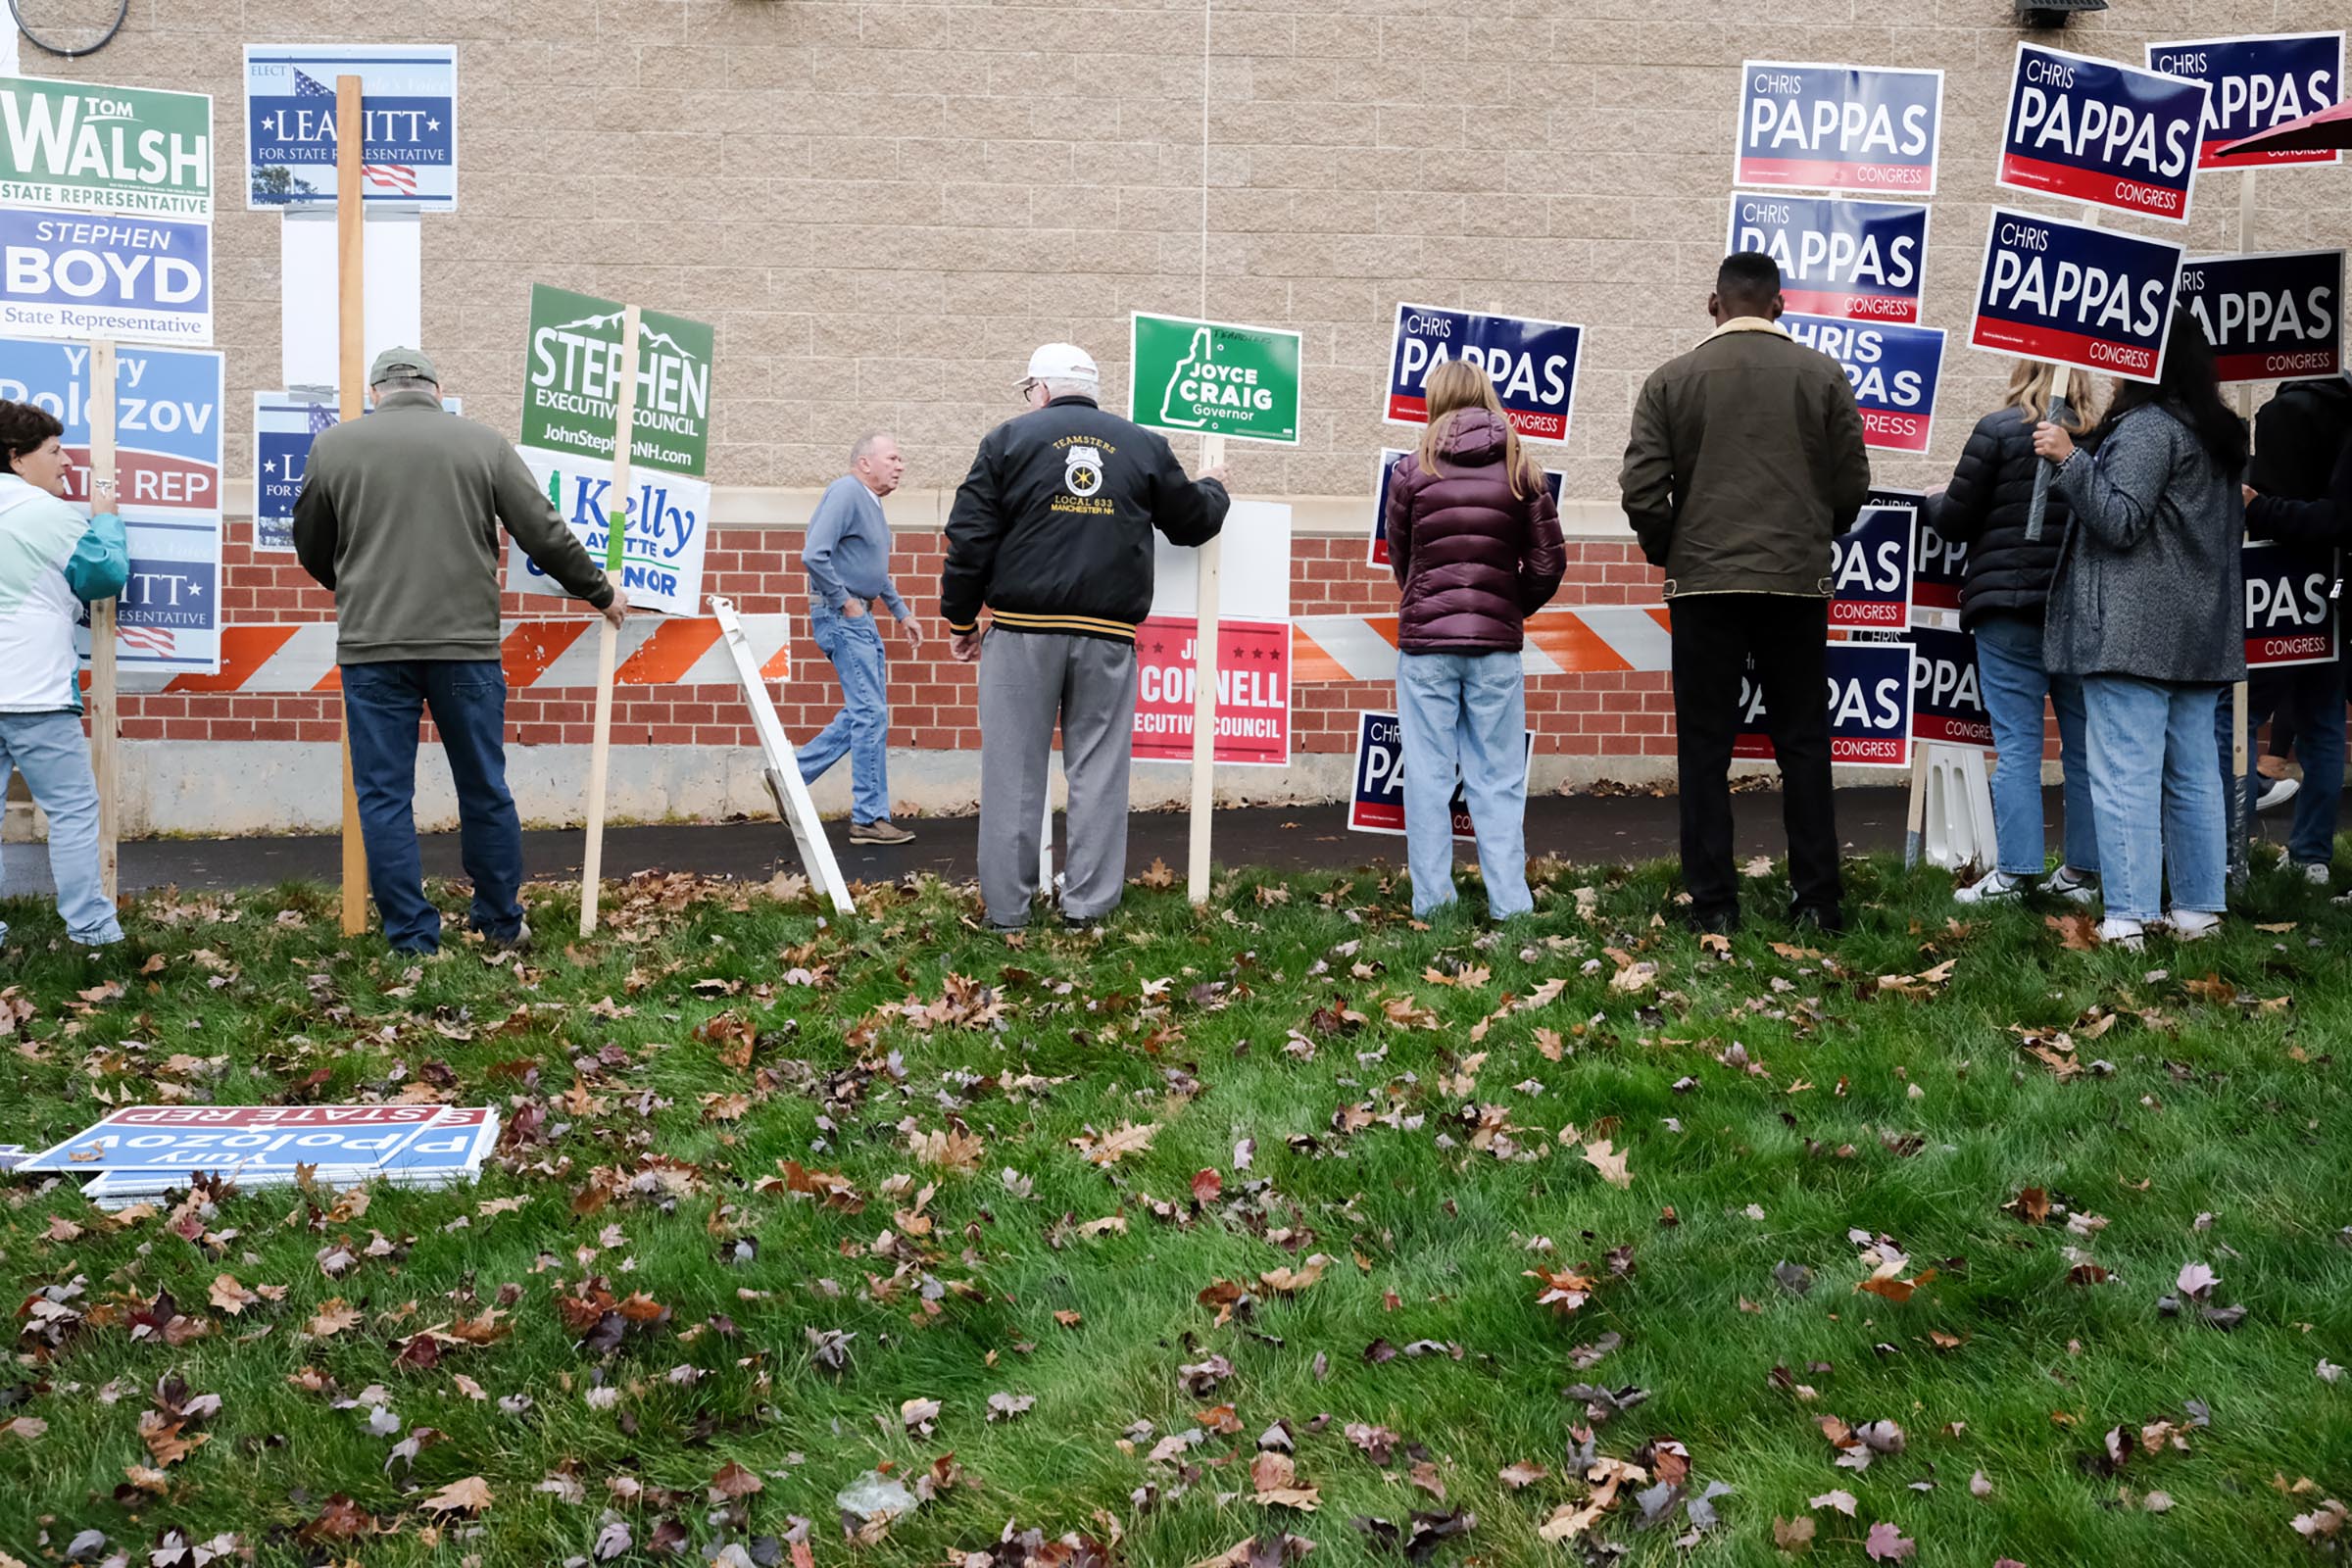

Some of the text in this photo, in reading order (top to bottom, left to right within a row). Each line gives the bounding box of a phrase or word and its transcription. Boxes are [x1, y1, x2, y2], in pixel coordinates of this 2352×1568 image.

[251, 65, 286, 76] ELECT
[2026, 60, 2076, 90] CHRIS
[2160, 53, 2208, 75] CHRIS
[1754, 74, 1802, 95] CHRIS
[84, 97, 134, 119] TOM
[2205, 70, 2331, 130] PPAS
[0, 90, 209, 188] WALSH
[274, 110, 427, 142] LEAITT
[1749, 97, 1929, 157] PAPPAS
[2014, 86, 2191, 178] PAPPAS
[259, 147, 445, 161] FOR STATE RESENTATIVE
[1857, 165, 1923, 185] CONGRESS
[1, 183, 52, 202] STATE
[61, 188, 208, 214] REPRESENTATIVE
[2115, 181, 2178, 211] CONGRESS
[1742, 203, 1790, 224] CHRIS
[35, 220, 172, 251] STEPHEN
[2000, 222, 2049, 252] CHRIS
[1740, 226, 1916, 288] PAPPAS
[6, 245, 202, 304] BOYD
[2179, 270, 2205, 292] RIS
[1844, 297, 1909, 316] CONGRESS
[1987, 249, 2165, 338] PAPPAS
[5, 307, 202, 334] State Representative
[1407, 315, 1452, 338] CHRIS
[2189, 286, 2332, 346] APPAS
[63, 346, 147, 388] Yry
[2089, 341, 2150, 369] CONGRESS
[2266, 353, 2330, 371] CONGRESS
[530, 326, 709, 419] STEPHEN
[1189, 362, 1258, 385] JOYCE
[1841, 364, 1922, 407] PAS
[0, 378, 213, 435] Polzov
[1179, 379, 1273, 411] CRAIG
[535, 388, 699, 437] EXECUTIV COUNCIL
[1193, 403, 1254, 421] Governor
[1865, 414, 1917, 436] RESS
[543, 422, 692, 466] JohnStephnNH.com
[1053, 435, 1116, 455] TEAMSTERS
[134, 469, 211, 502] REP
[266, 484, 292, 497] FOR
[1051, 504, 1102, 514] MANCHESTER
[1054, 495, 1113, 508] LOCAL 633
[570, 475, 696, 559] Kelly
[585, 532, 657, 557] AYTTE
[1831, 540, 1901, 593] PAS
[1834, 603, 1897, 620] CONGRESS
[2246, 573, 2328, 629] PAS
[81, 608, 206, 625] RESENTATIVE
[1181, 638, 1198, 661] JI
[2265, 636, 2327, 656] CONGRESS
[1140, 665, 1285, 709] CONNELL
[1915, 657, 1982, 711] PPA
[1134, 712, 1281, 739] ECUTIV COUNCIL
[1371, 722, 1402, 744] CHR
[1945, 720, 1994, 740] CONGRE
[1831, 740, 1897, 758] CONGRESS
[125, 1108, 241, 1122] REP
[248, 1107, 428, 1121] STATE
[74, 1133, 403, 1152] Polozov
[148, 1150, 267, 1164] Yury
